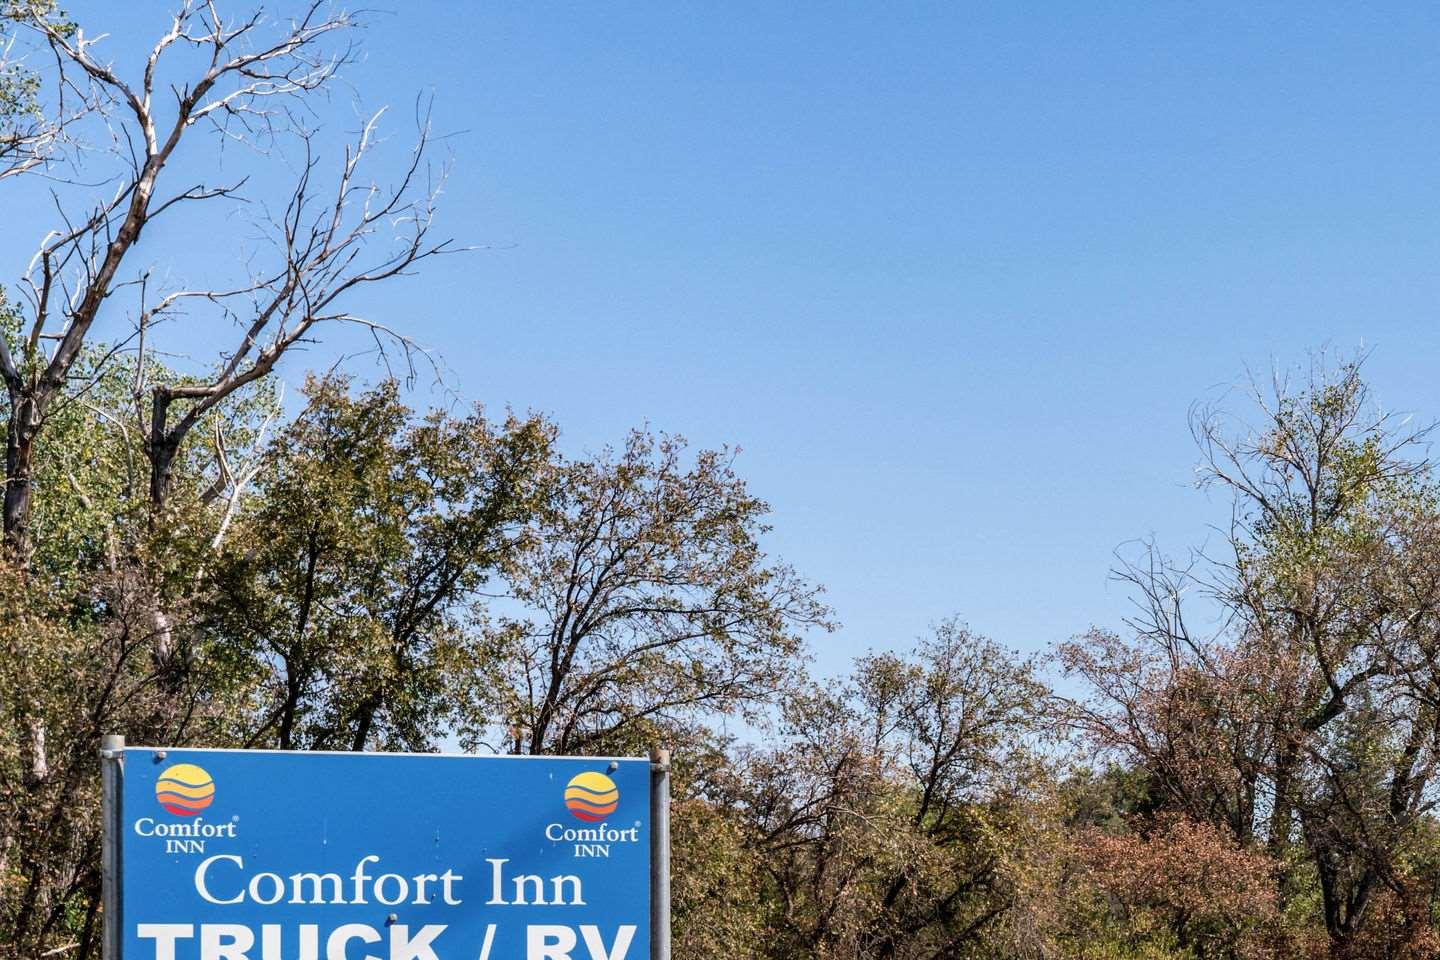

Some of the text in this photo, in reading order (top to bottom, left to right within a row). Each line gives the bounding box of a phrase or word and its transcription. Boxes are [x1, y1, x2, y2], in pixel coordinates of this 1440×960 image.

[166, 839, 205, 853] INN
[574, 844, 610, 857] INN
[195, 855, 586, 905] Comfort Inn
